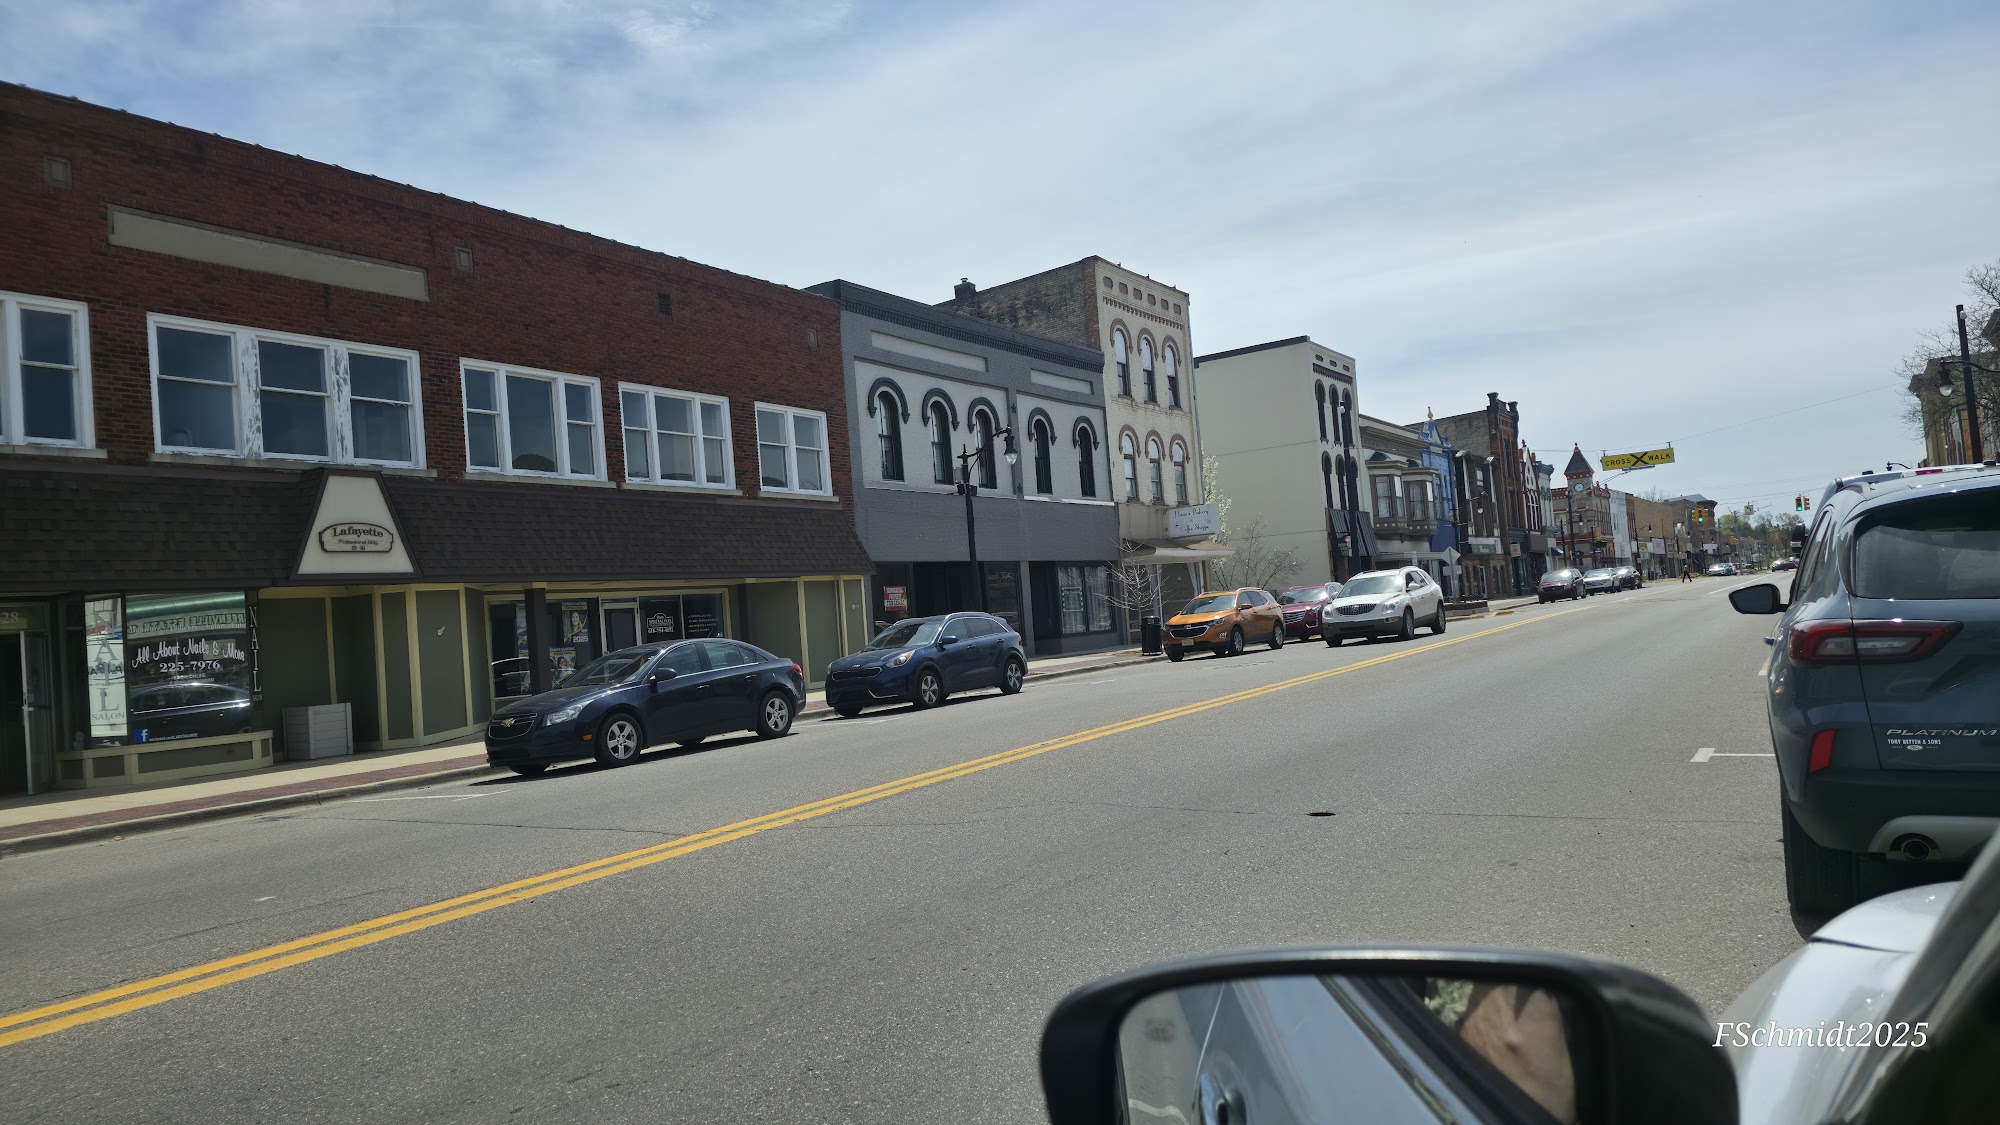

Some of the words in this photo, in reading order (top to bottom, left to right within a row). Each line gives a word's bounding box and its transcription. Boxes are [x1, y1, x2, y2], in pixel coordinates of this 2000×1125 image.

[1605, 458, 1632, 467] CROSS
[1648, 453, 1671, 461] WALK
[332, 526, 384, 538] Lafayette
[132, 645, 150, 668] All
[153, 641, 180, 660] About
[183, 638, 209, 655] Nails
[212, 641, 219, 655] &
[222, 642, 245, 661] More
[159, 660, 221, 673] 225-7976
[92, 712, 125, 721] SALON
